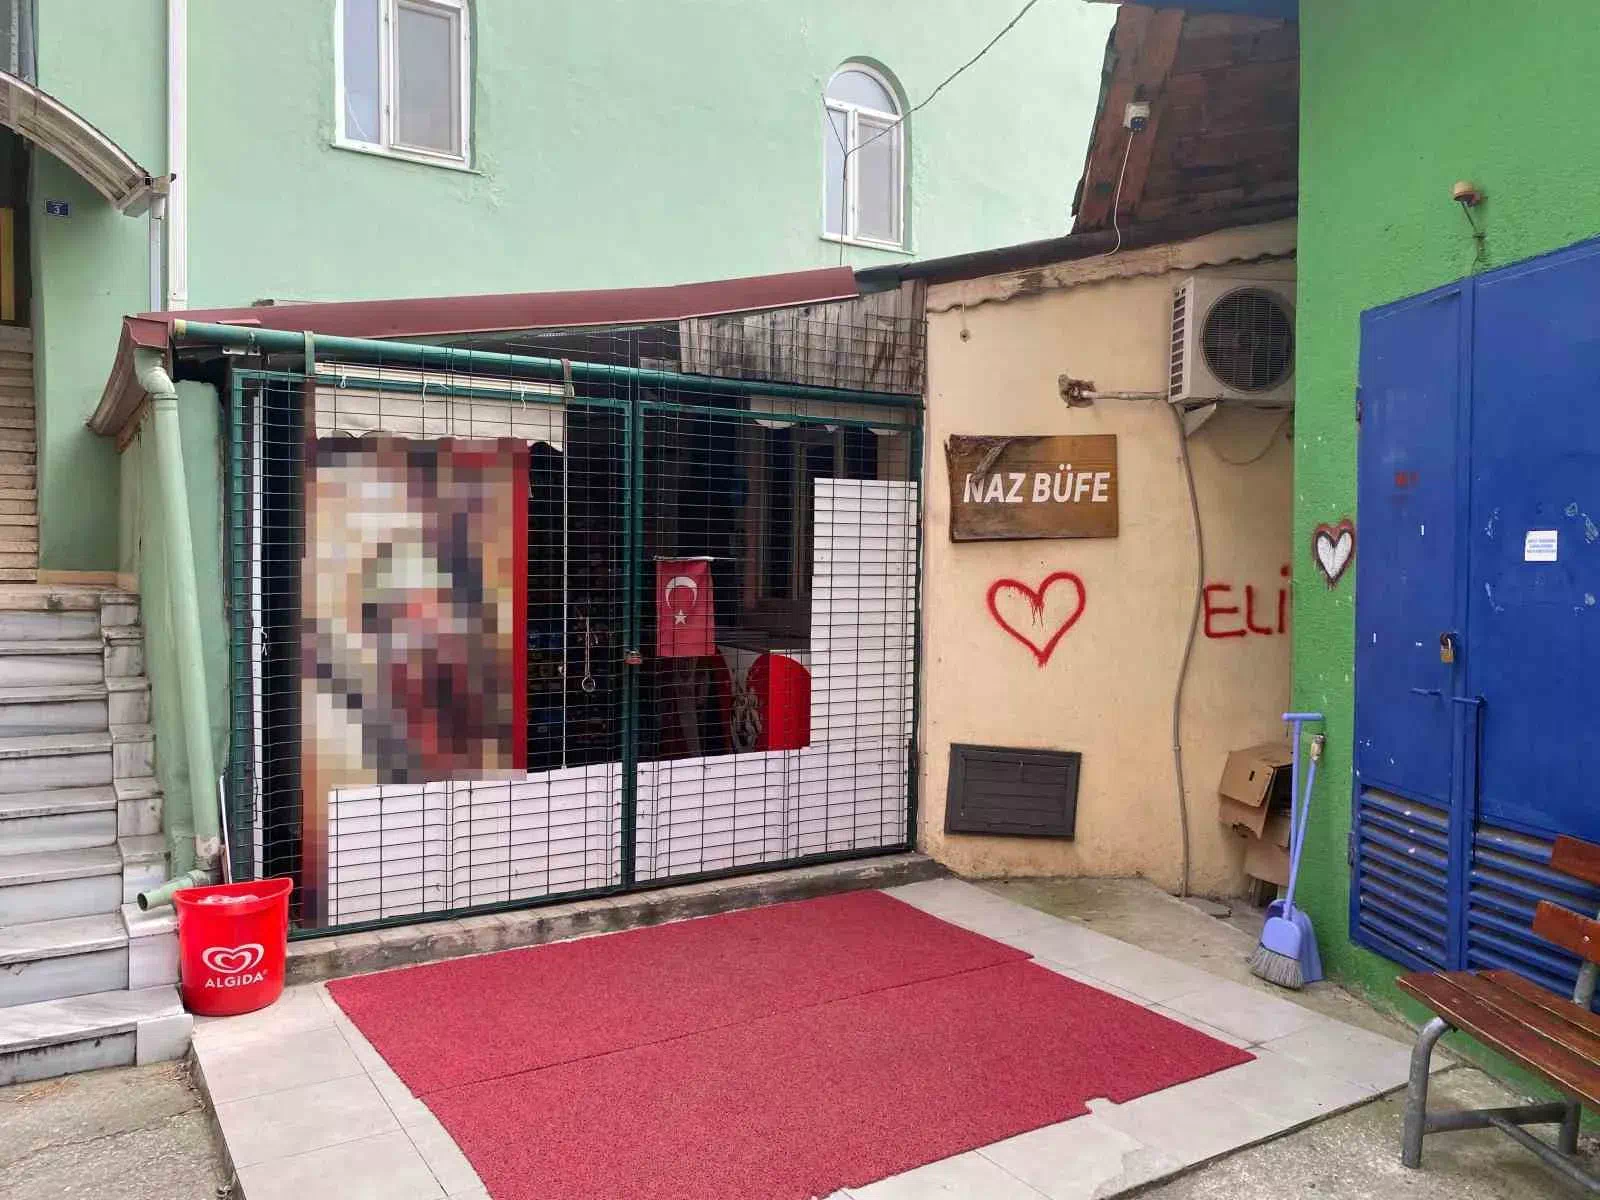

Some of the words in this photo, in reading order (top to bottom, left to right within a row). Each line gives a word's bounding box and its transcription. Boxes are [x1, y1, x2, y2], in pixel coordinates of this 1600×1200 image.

[963, 472, 1026, 504] NAZ
[1031, 463, 1111, 504] BÜFE
[204, 971, 264, 988] ALGIDA
